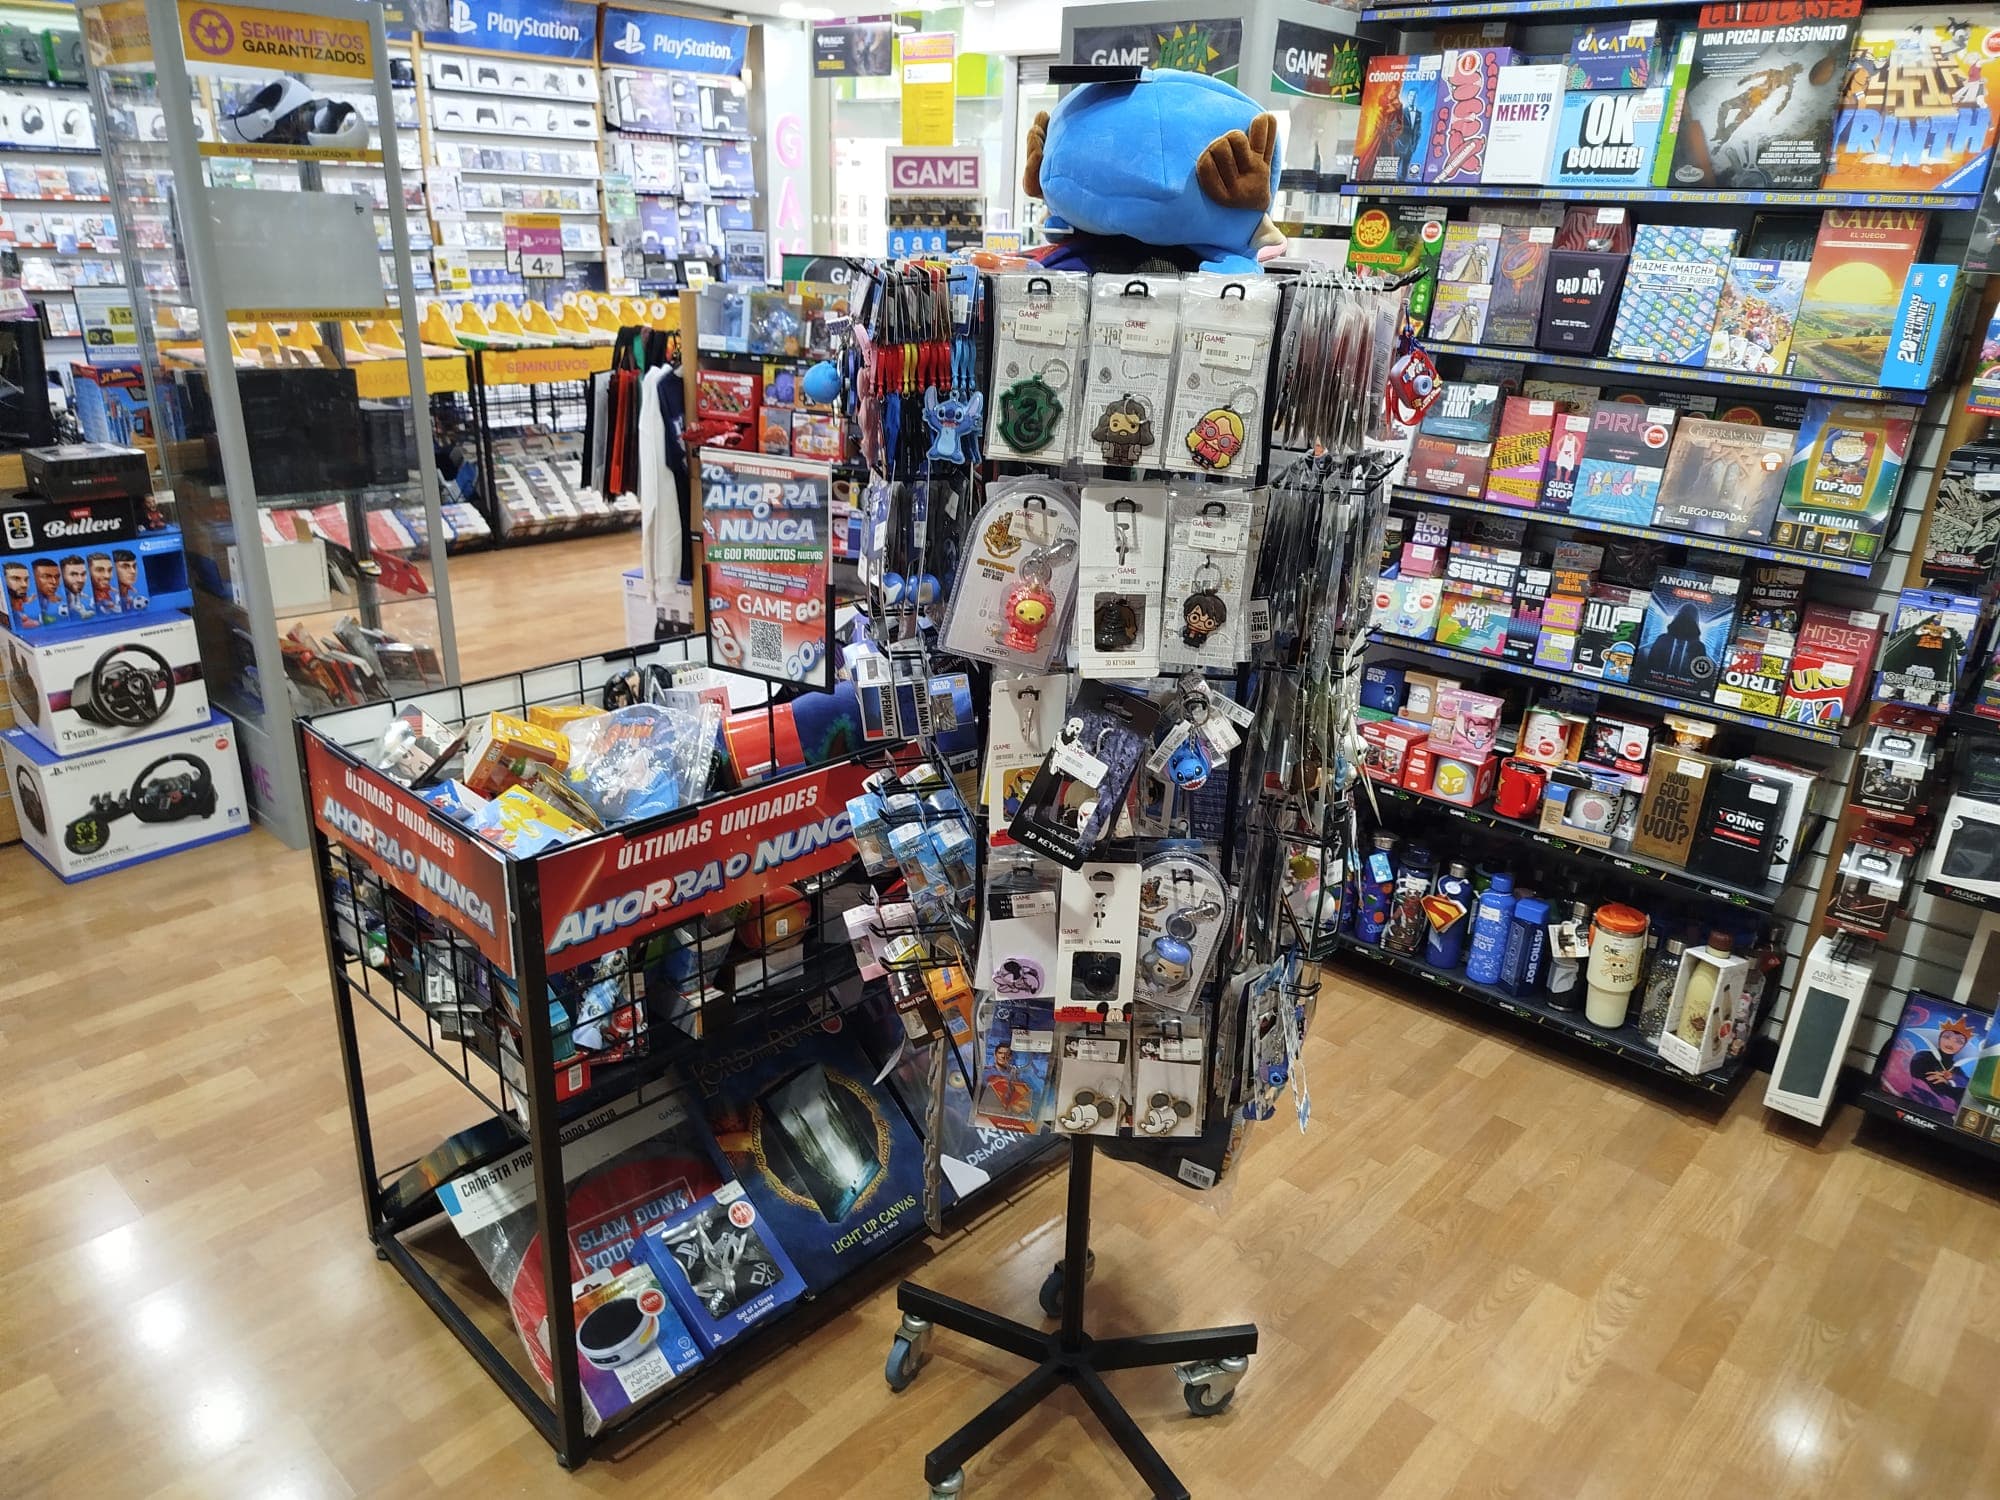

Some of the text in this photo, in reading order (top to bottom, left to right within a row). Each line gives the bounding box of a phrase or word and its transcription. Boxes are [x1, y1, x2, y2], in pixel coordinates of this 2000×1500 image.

[240, 20, 364, 50] SEMINUEVOS
[487, 14, 582, 42] PlayStation
[1702, 25, 1848, 46] UNA PIZCA DE ASESINATO
[242, 39, 366, 65] GARANTIZADOS
[653, 33, 732, 61] PlayStation
[1091, 47, 1149, 66] GAME
[1285, 48, 1327, 78] GAME
[1369, 70, 1437, 82] CÓDIGO SECRETO
[1500, 93, 1552, 103] WHAT DO YOU
[1496, 104, 1550, 122] MEME?
[1585, 95, 1639, 144] OK
[1566, 147, 1645, 168] BOOMER!
[897, 160, 975, 187] GAME
[1942, 153, 1987, 190] Ravensburger
[1828, 209, 1915, 231] CATAN
[1635, 261, 1715, 274] HAZME «MATCH»
[1557, 278, 1605, 296] BAD DAY
[1688, 276, 1716, 284] PUEDES
[1019, 310, 1040, 320] GAME
[1125, 321, 1146, 329] GAME
[1204, 334, 1226, 344] GAME
[1897, 340, 1918, 364] 20
[506, 359, 590, 374] SEMINUEVOS
[1441, 401, 1471, 418] TAKA
[1520, 433, 1549, 447] CROSS
[1497, 451, 1533, 466] THE LINE
[734, 464, 792, 480] ÚLTIMAS UNIDADES
[704, 482, 819, 507] AHORRA
[1545, 487, 1573, 499] STOP
[1549, 480, 1574, 491] QUICK
[1815, 479, 1862, 496] TOP 200
[752, 502, 772, 521] O
[1679, 505, 1748, 523] FUEGO ESPADAS
[1799, 511, 1860, 530] KIT INICIAL
[719, 518, 815, 541] NUNCA
[1193, 520, 1214, 529] GAME
[1412, 533, 1448, 545] ADOS
[714, 548, 823, 560] DE 600 PRODUCTOS NUEVOS
[1448, 563, 1510, 587] SERIE
[1518, 583, 1548, 597] PLAY HIT
[1752, 587, 1799, 599] NO MERCY
[737, 594, 792, 622] GAME
[1803, 623, 1871, 648] HITSTER
[1367, 674, 1384, 683] BOT
[1725, 671, 1778, 694] TRIO
[880, 685, 894, 728] SUPERMAN
[914, 683, 930, 728] IRON MAN
[1666, 772, 1689, 786] HOW
[1659, 783, 1690, 800] GOLD
[345, 766, 455, 858] ÚLTIMAS UNIDADES
[1651, 799, 1689, 821] ARE
[617, 785, 818, 870] ÚLTIMAS UNIDADES
[1643, 815, 1690, 845] YOU?
[1719, 810, 1765, 832] VOTING
[1025, 830, 1075, 860] 3D KEYCHAIN
[324, 796, 402, 869] AHORRA
[418, 855, 496, 934] NUNCA
[547, 858, 724, 953] AHORRA
[754, 812, 856, 872] NUNC
[1951, 888, 1987, 903] MAGIC
[1526, 929, 1544, 984] ASTRO BOT
[1603, 945, 1620, 956] ONE
[1904, 1114, 1938, 1131] MAGIC
[461, 1164, 512, 1197] CANASTA
[578, 1190, 687, 1251] SLAM DUNK
[831, 1195, 917, 1255] LIGHT UP CANVAS
